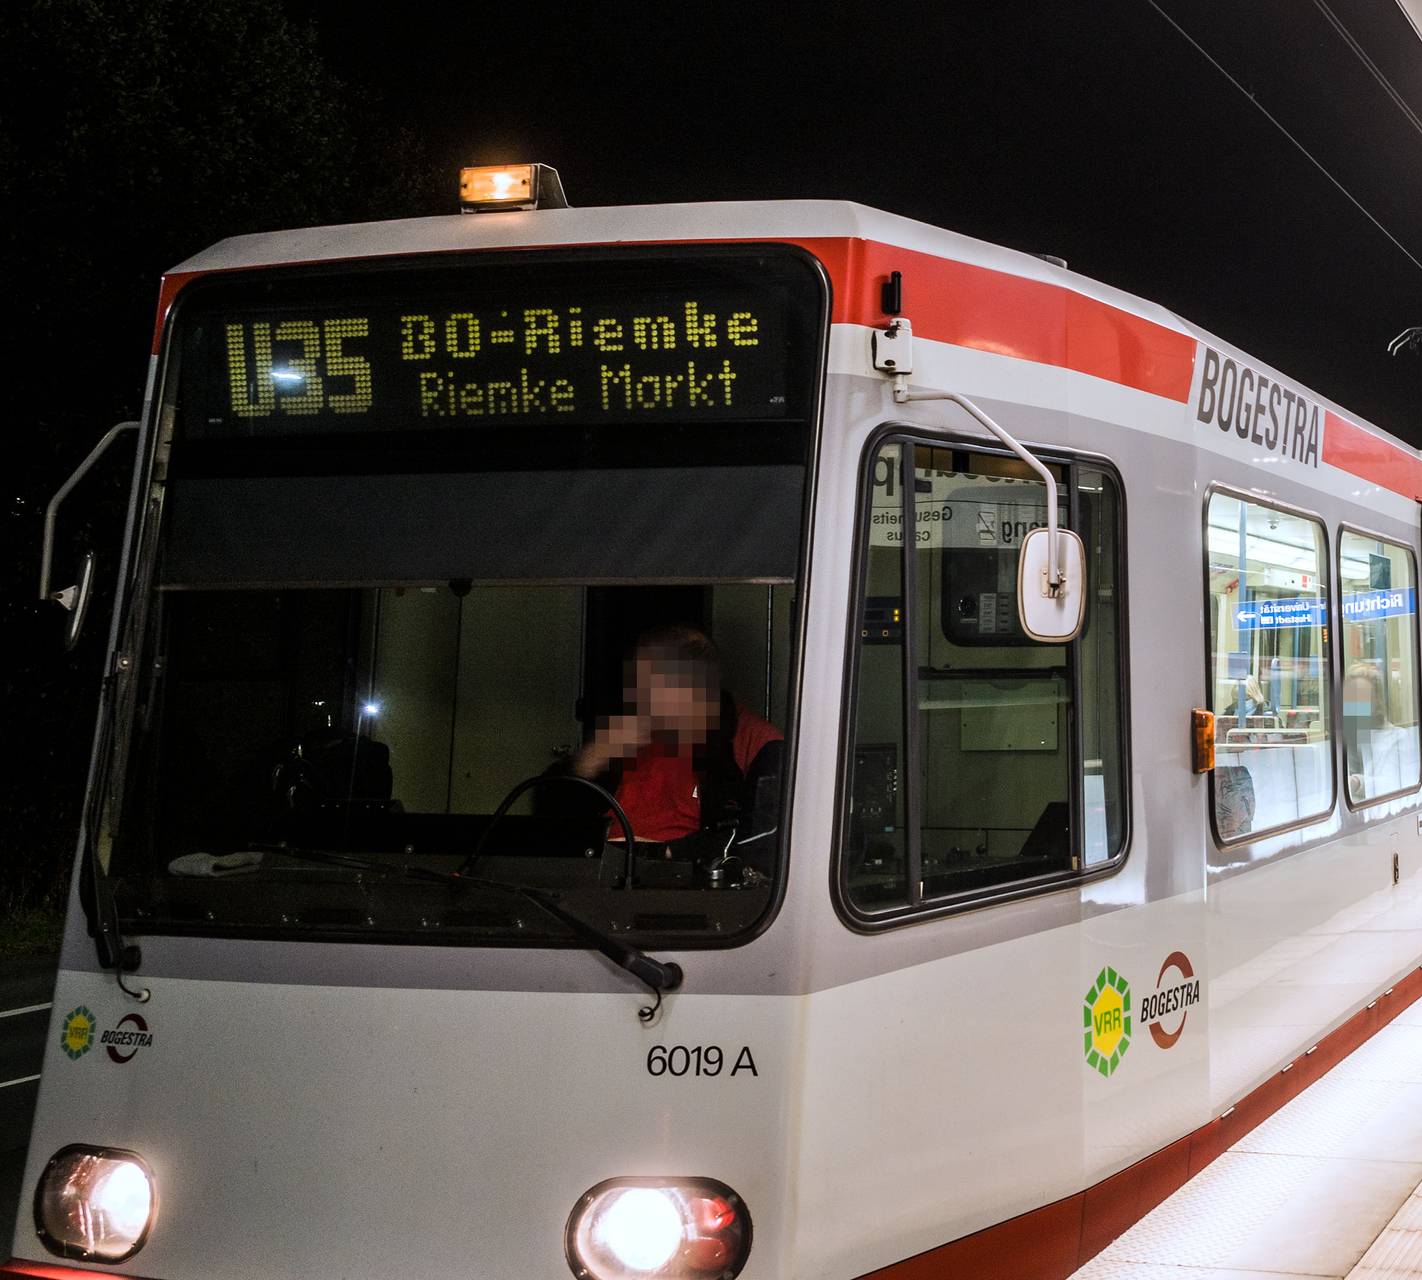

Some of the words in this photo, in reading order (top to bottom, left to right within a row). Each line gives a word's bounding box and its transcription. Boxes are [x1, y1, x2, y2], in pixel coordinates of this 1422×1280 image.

[400, 302, 759, 361] BO-Riemke
[225, 318, 373, 418] U35
[420, 366, 577, 418] Riemke
[599, 360, 737, 411] Markt
[1197, 347, 1320, 469] BOGESTRA
[1094, 1007, 1122, 1037] VRR
[1140, 980, 1200, 1023] BOGESTRA
[100, 1030, 153, 1048] BOGESTRA
[646, 1044, 724, 1079] 6019
[730, 1046, 759, 1078] A
